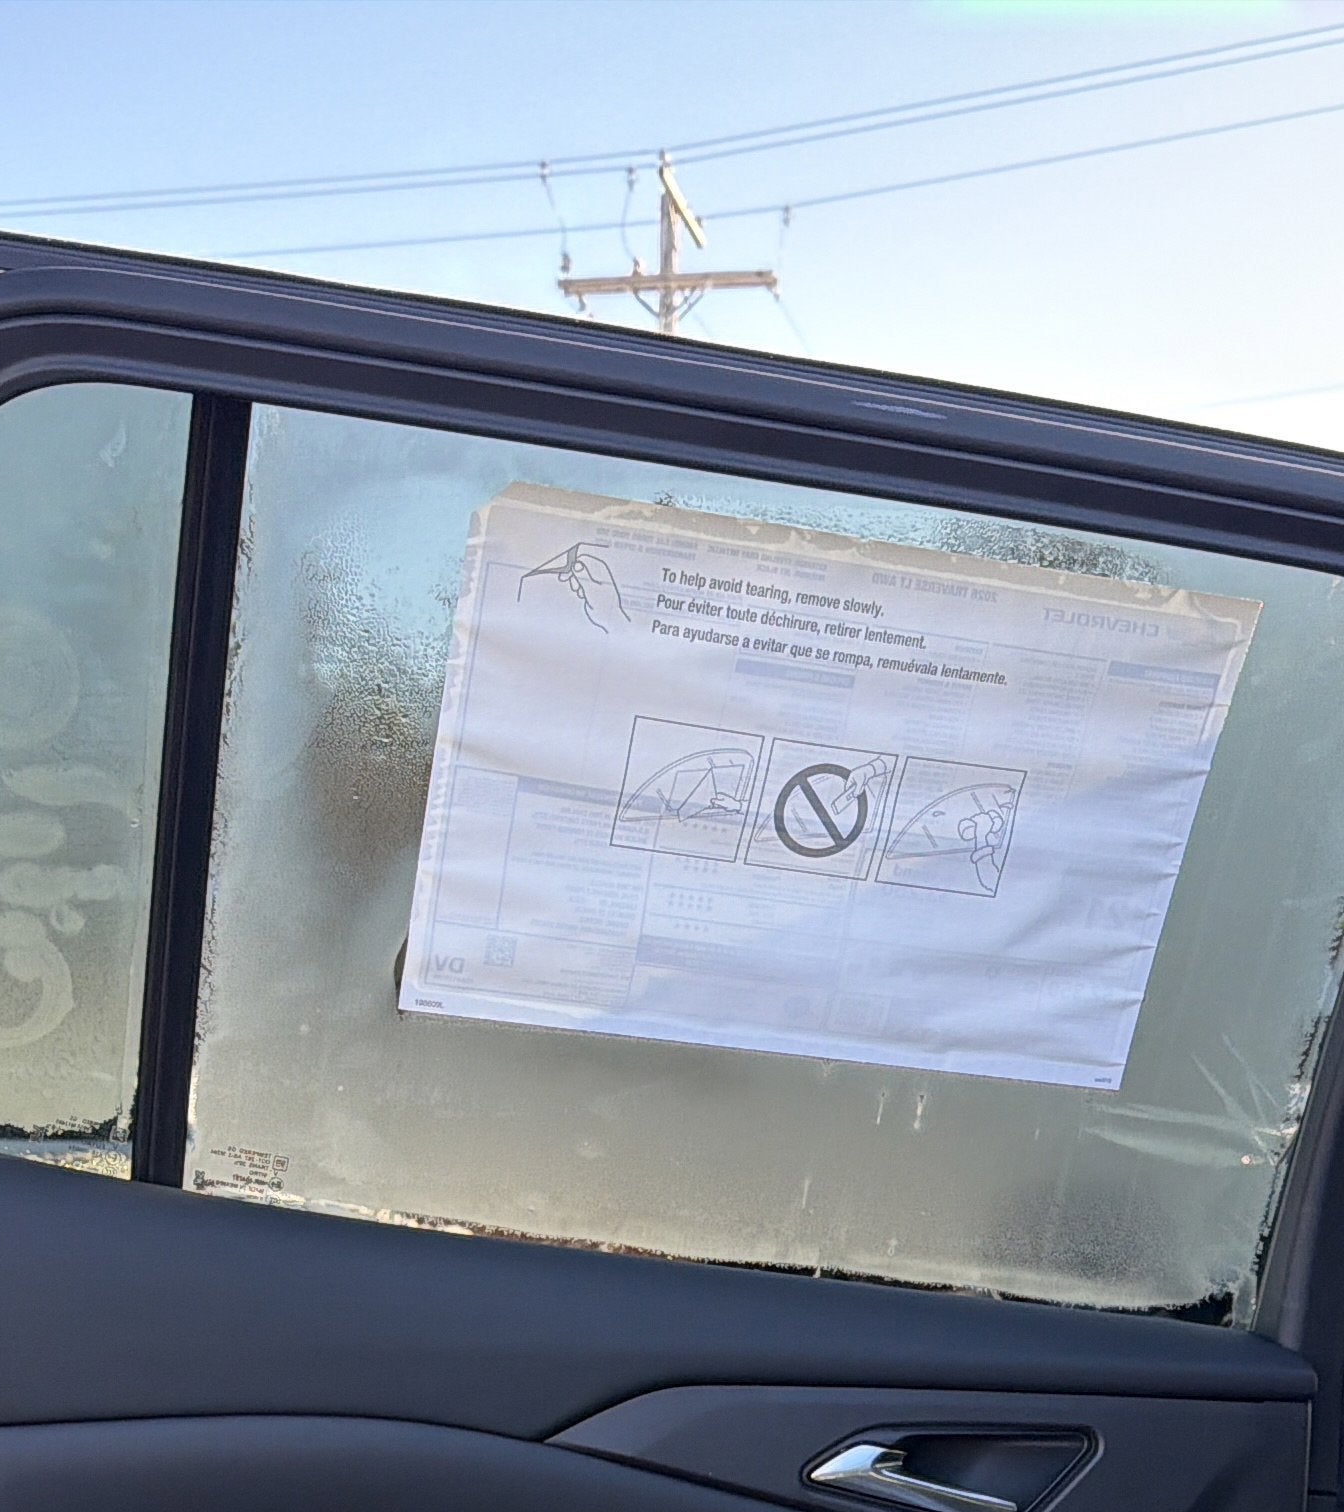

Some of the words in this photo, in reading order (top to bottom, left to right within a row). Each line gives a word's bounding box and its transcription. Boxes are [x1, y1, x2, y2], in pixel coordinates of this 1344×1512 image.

[662, 568, 676, 583] To
[680, 570, 706, 590] help
[709, 577, 743, 593] avoid
[746, 582, 791, 604] tearing,
[795, 592, 840, 609] remove
[843, 598, 884, 618] slowly.
[656, 594, 685, 611] Pour
[688, 598, 723, 618] éviter
[726, 605, 757, 623] toute
[760, 611, 820, 635] déchirure,
[824, 623, 862, 639] retirer
[865, 627, 926, 650] lentement.
[651, 619, 679, 637] Para
[683, 626, 739, 647] ayudarse
[742, 636, 750, 648] a
[753, 637, 787, 653] evitar
[790, 643, 812, 658] que
[815, 646, 830, 660] se
[832, 650, 873, 669] rompa,
[876, 656, 938, 676] remuévala
[940, 663, 1007, 685] lentamente.
